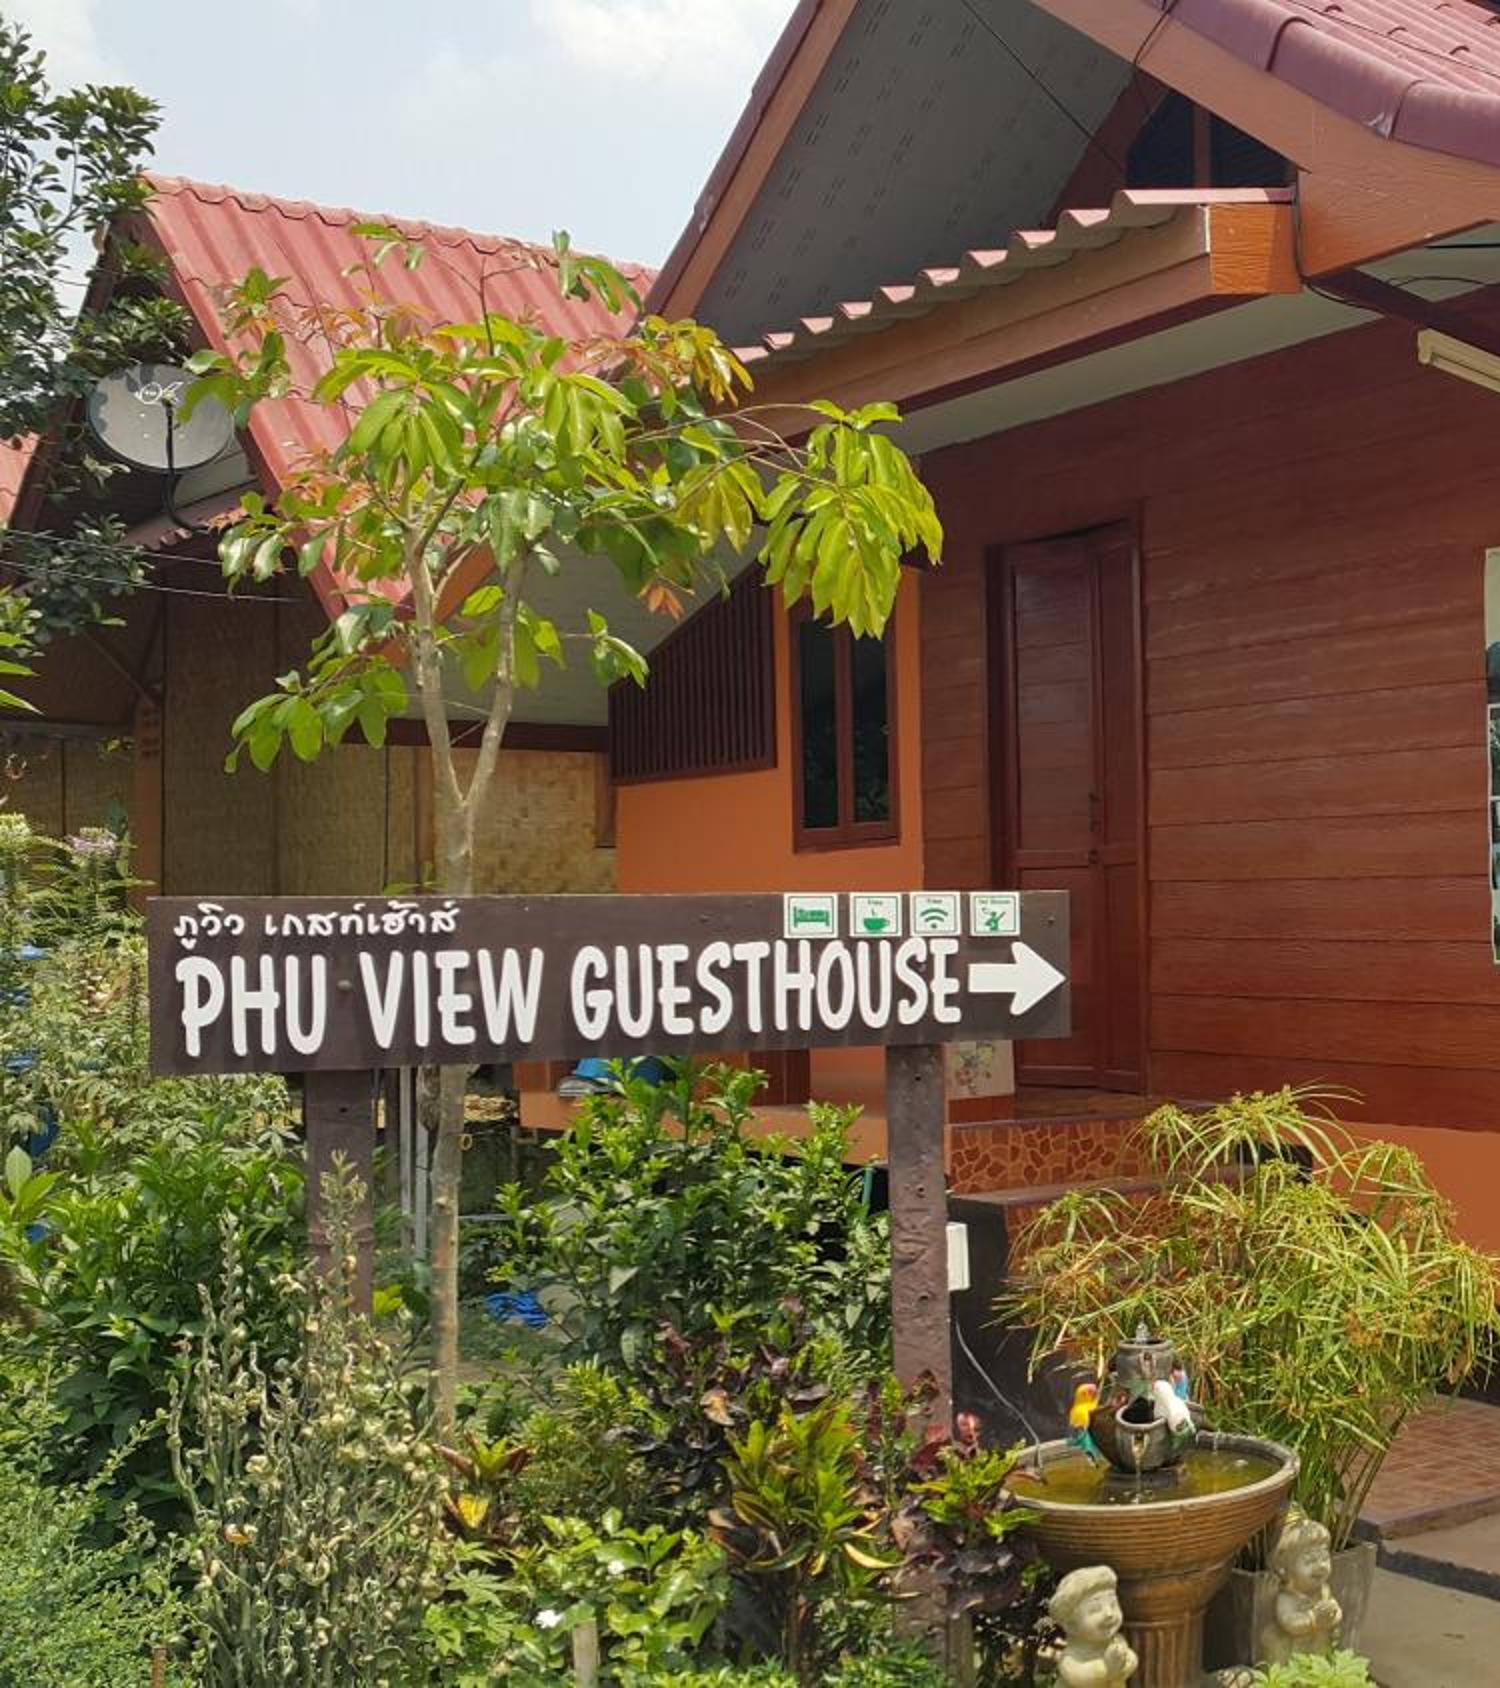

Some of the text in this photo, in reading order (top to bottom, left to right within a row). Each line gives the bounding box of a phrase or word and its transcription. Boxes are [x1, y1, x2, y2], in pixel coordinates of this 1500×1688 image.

[174, 902, 245, 949] ภูวิว
[175, 937, 962, 1057] PHU VIEW GUESTHOUSE
